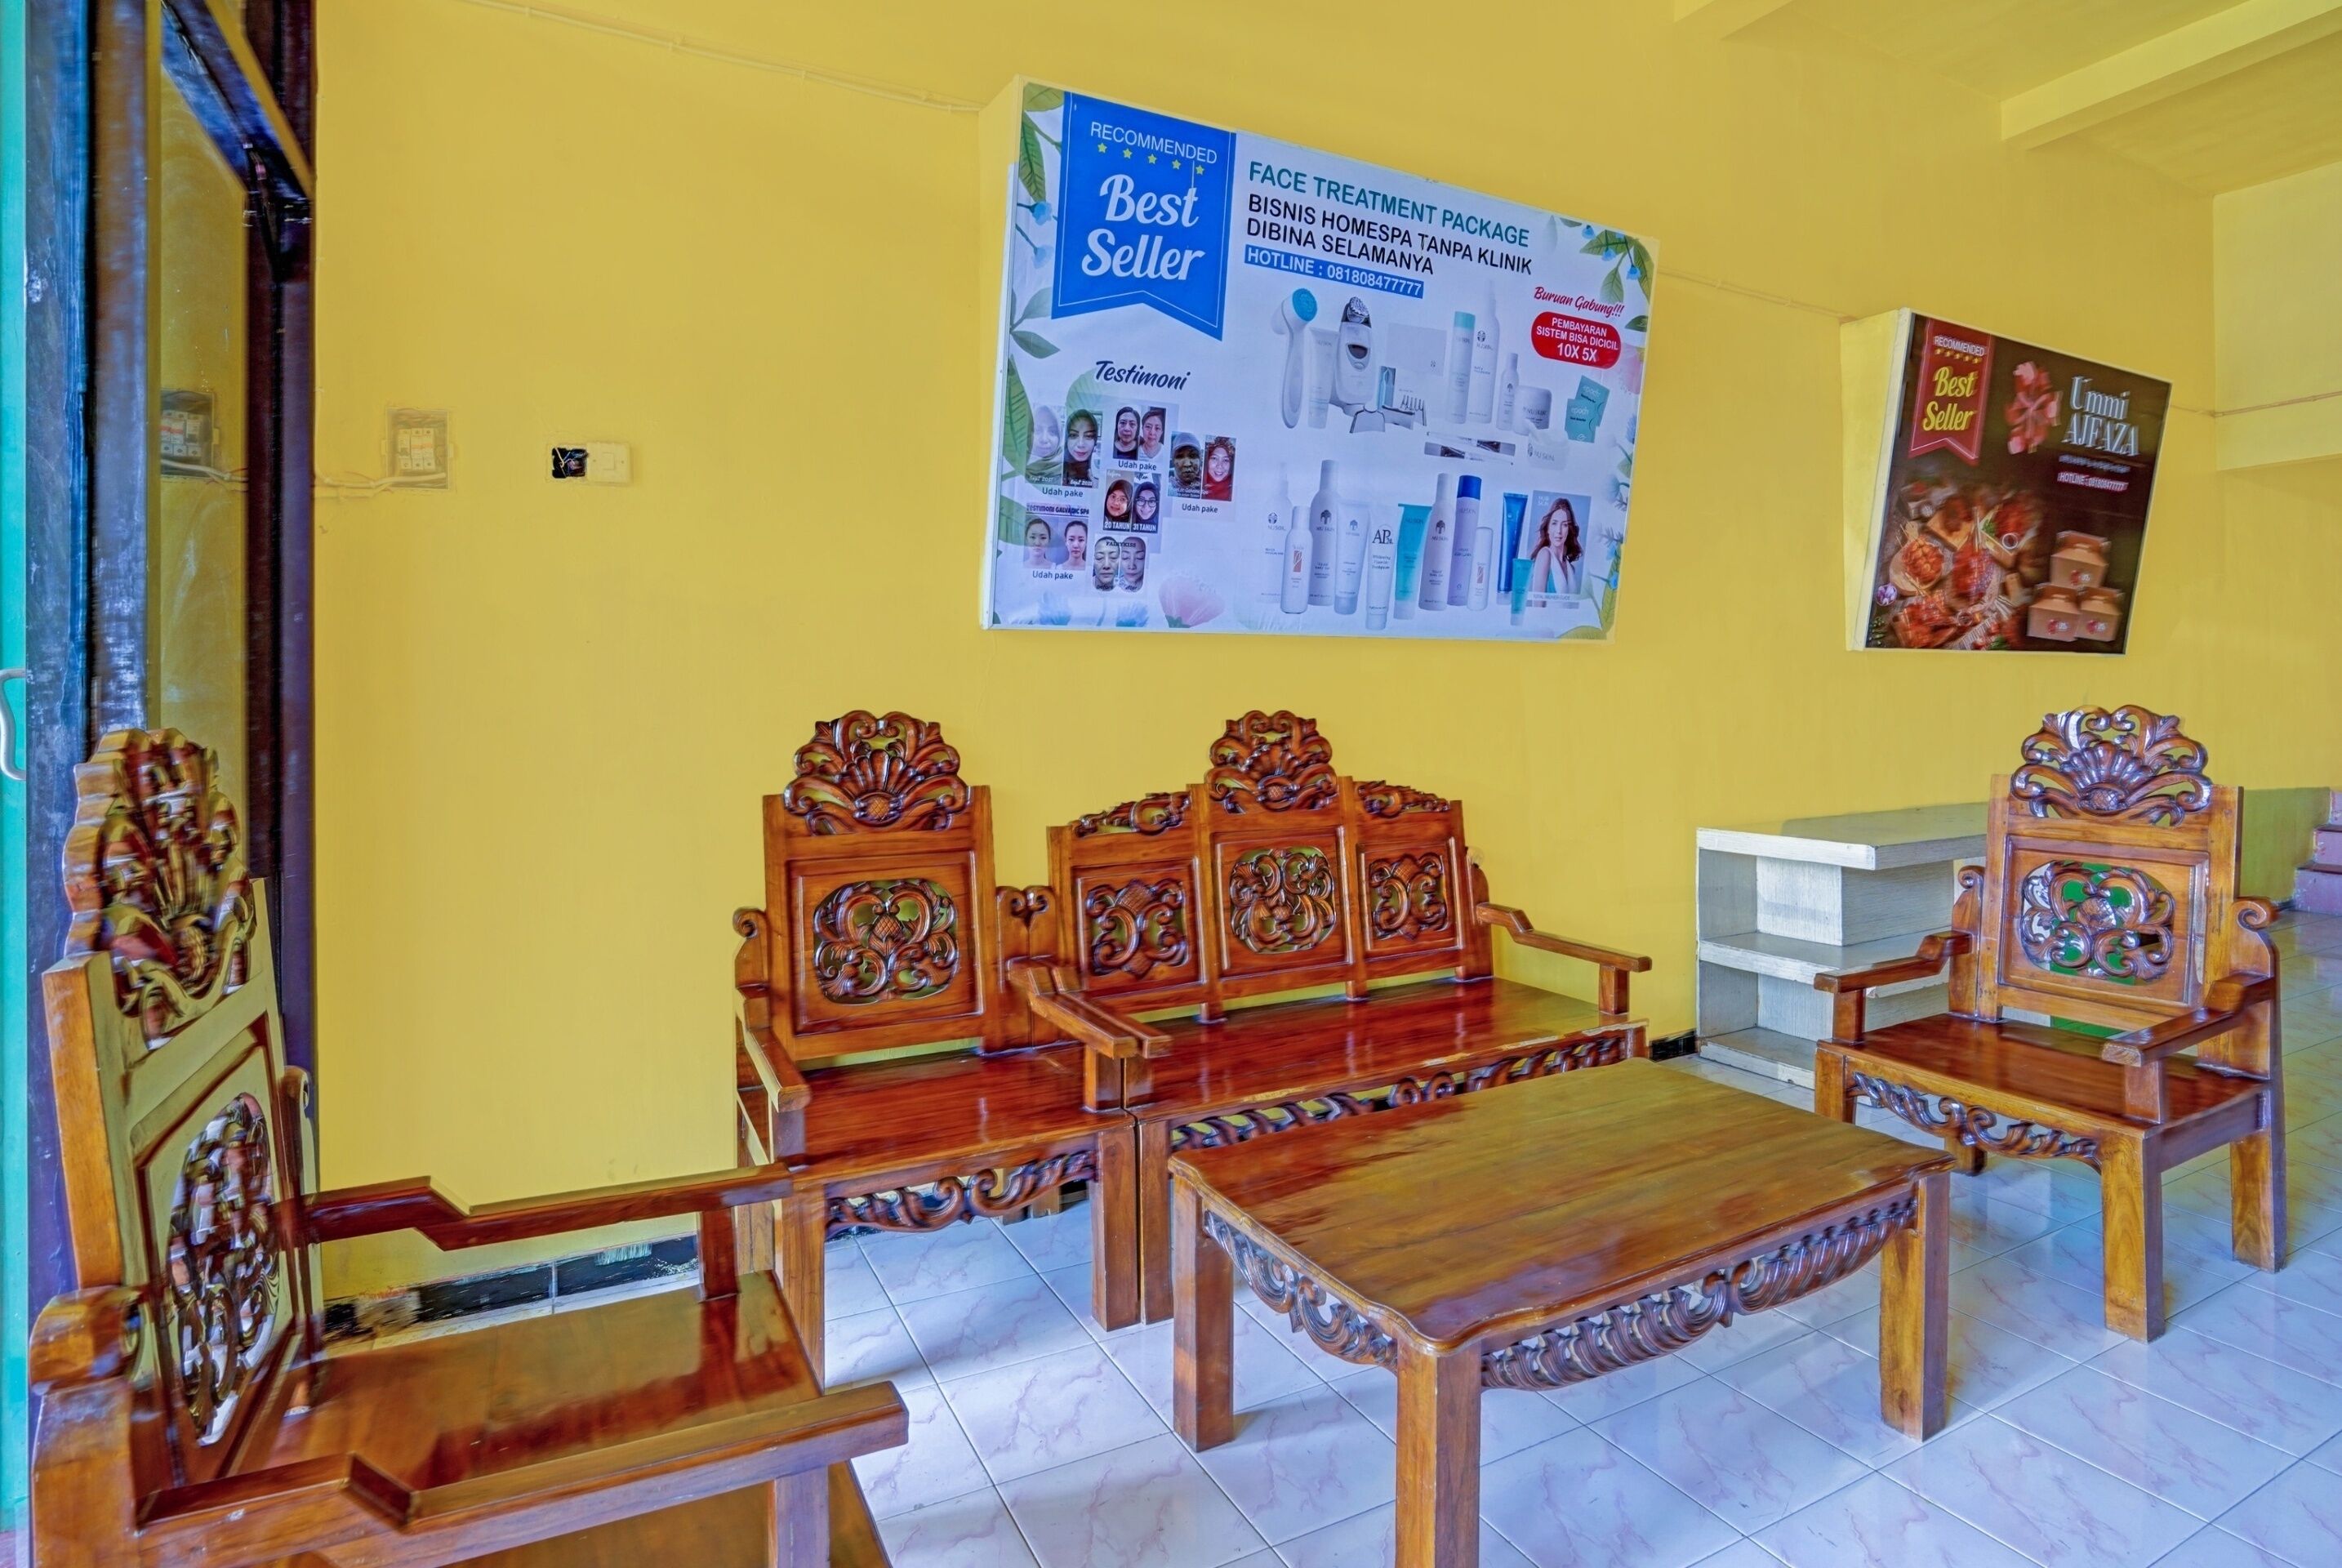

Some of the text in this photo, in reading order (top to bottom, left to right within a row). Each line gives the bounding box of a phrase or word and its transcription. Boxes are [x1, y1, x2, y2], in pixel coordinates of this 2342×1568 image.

[1091, 122, 1218, 164] RECOMMENDED
[1100, 174, 1199, 227] Best
[1249, 162, 1529, 247] FACE TREATMENT PACKAGE
[1247, 218, 1433, 274] DIBINA SELAMANYA
[1249, 194, 1532, 274] BISNIS HOMESPA TANPA KLINIK
[1081, 229, 1205, 281] Seller
[1248, 247, 1314, 275] HOTLINE
[1327, 265, 1422, 296] 081808477777
[1534, 287, 1625, 318] Buruan Gabung!!!
[1536, 326, 1618, 350] SISTEM BISA DICICIL
[1552, 318, 1607, 336] PEMBAYARAN
[1557, 343, 1597, 362] 10X 5X
[1933, 336, 1985, 357] RECOMMENDED
[1095, 361, 1191, 390] Testimoni
[1933, 367, 1978, 398] Best
[2070, 376, 2130, 420] Ummi
[1923, 401, 1976, 431] Seller
[2061, 413, 2140, 457] AJFAZA
[1118, 461, 1157, 471] Udah pake
[2060, 472, 2085, 485] HOTLINE
[1065, 489, 1084, 497] pake
[1182, 503, 1218, 514] Udah pake
[1113, 521, 1130, 530] TAHUN
[1140, 523, 1156, 532] TAHUN
[1032, 570, 1074, 581] Udah pake
